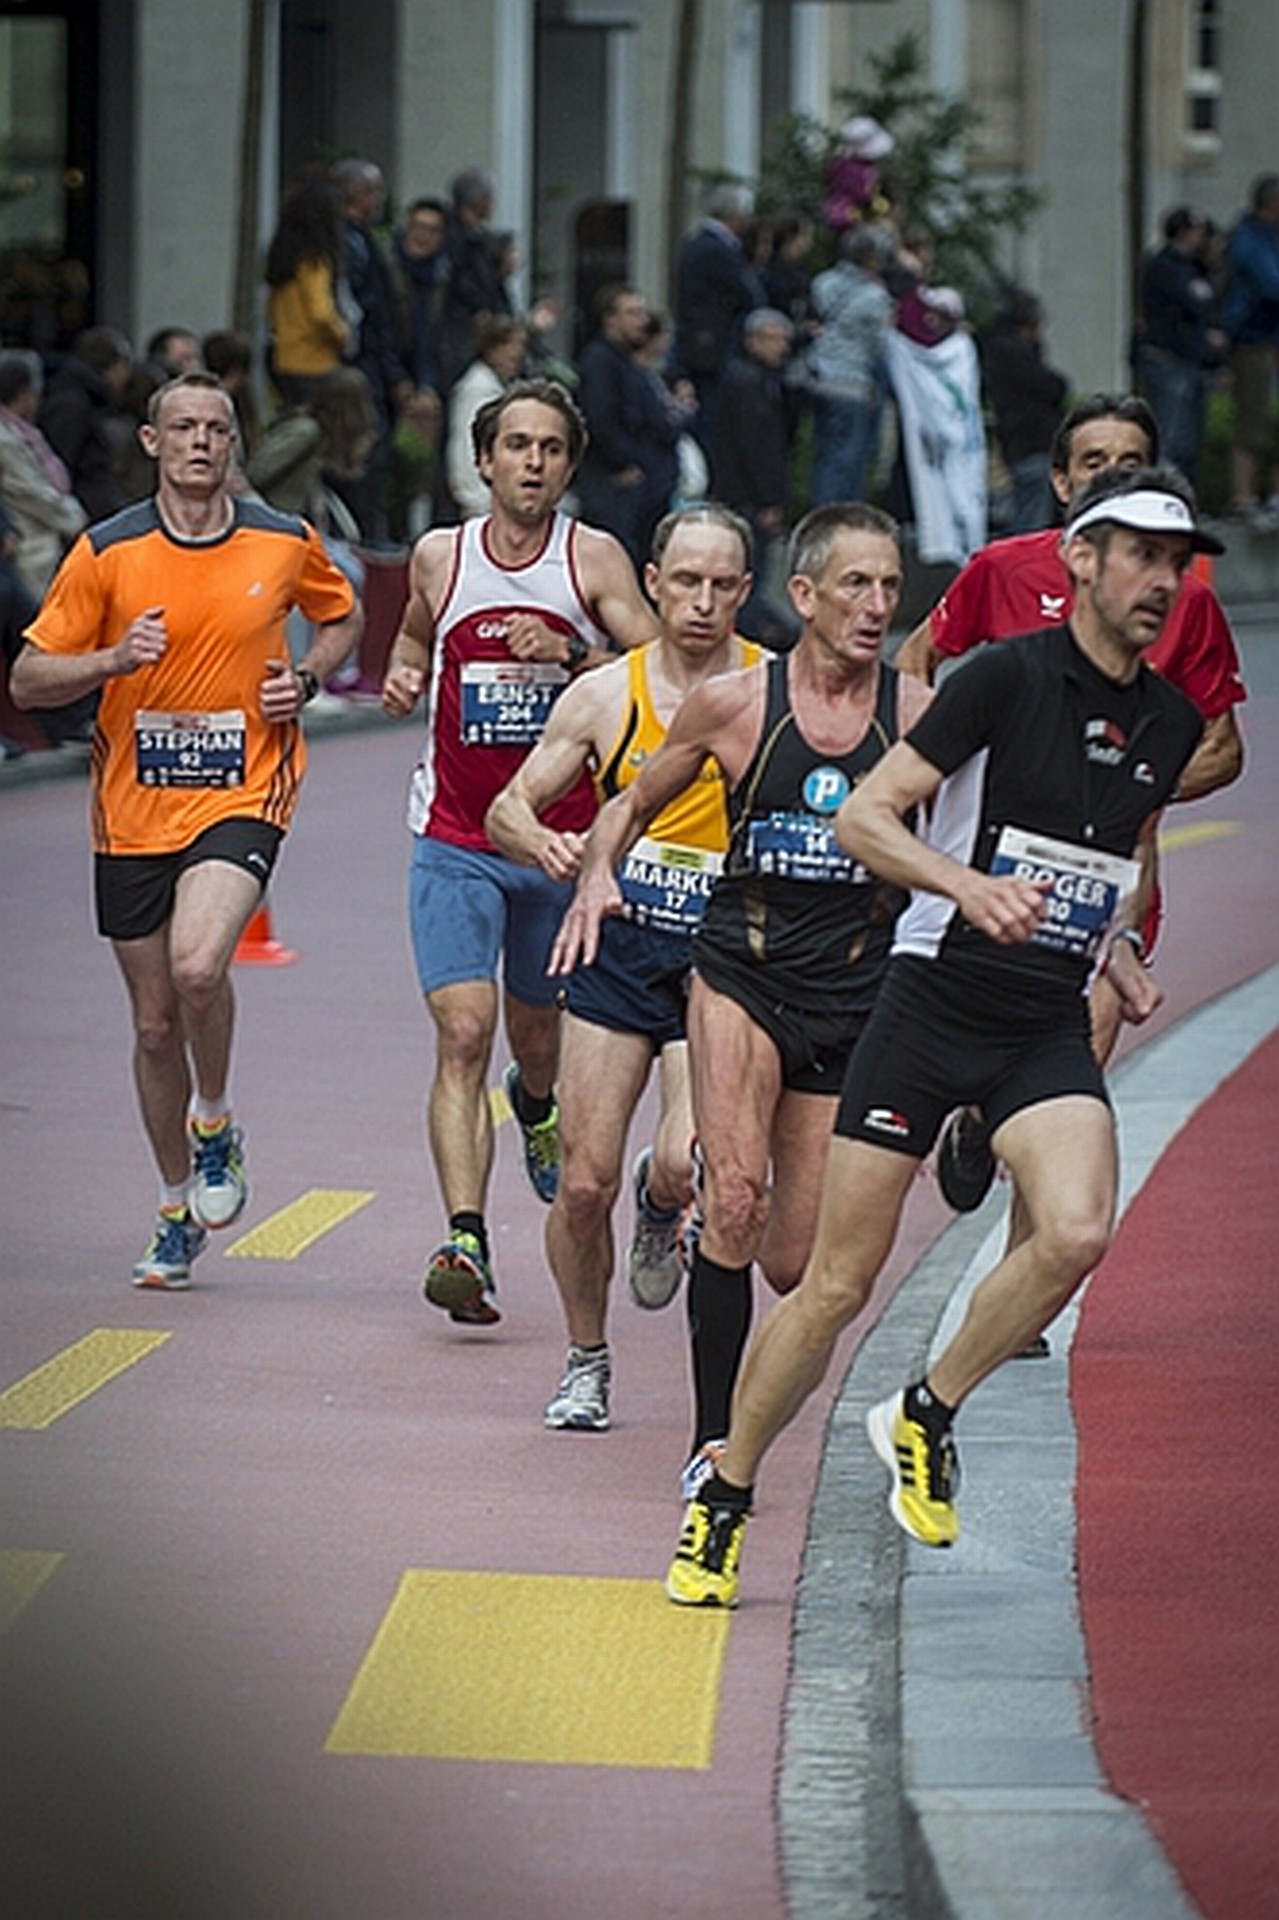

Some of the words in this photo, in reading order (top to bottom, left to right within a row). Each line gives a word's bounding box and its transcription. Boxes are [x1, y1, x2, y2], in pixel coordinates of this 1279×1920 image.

[478, 683, 553, 704] ERNST
[139, 732, 242, 750] STEPHAN
[814, 773, 839, 803] P
[1014, 861, 1107, 907] ROGER
[665, 891, 687, 909] 17
